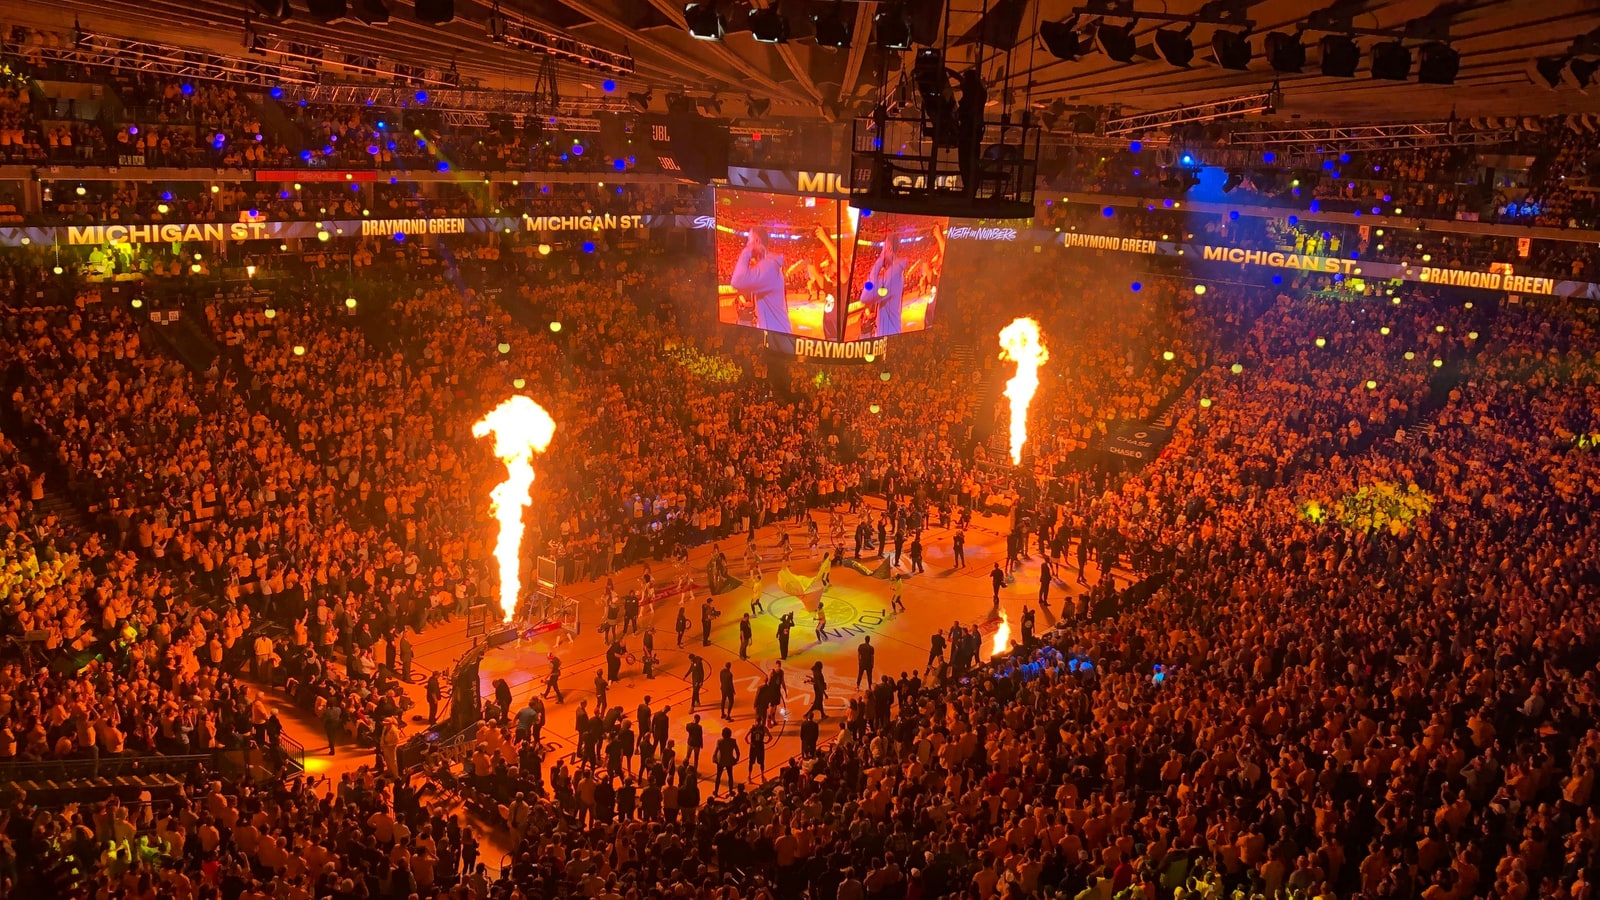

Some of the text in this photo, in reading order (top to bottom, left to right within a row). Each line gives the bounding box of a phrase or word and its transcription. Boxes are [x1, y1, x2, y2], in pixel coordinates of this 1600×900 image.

[652, 125, 670, 141] JBL
[658, 157, 680, 170] JBL
[362, 218, 465, 235] DRAYMOND GREEN
[526, 215, 644, 232] MICHIGAN ST.
[68, 223, 270, 245] MICHIGAN ST.
[1064, 232, 1156, 254] DRAYMOND GREEN
[1203, 245, 1319, 272] MICHIGAN
[1421, 267, 1554, 295] DRAYMOND GREEN
[795, 338, 871, 359] DRAYMOND
[1116, 436, 1152, 448] CHASE
[1109, 446, 1135, 457] CHASE
